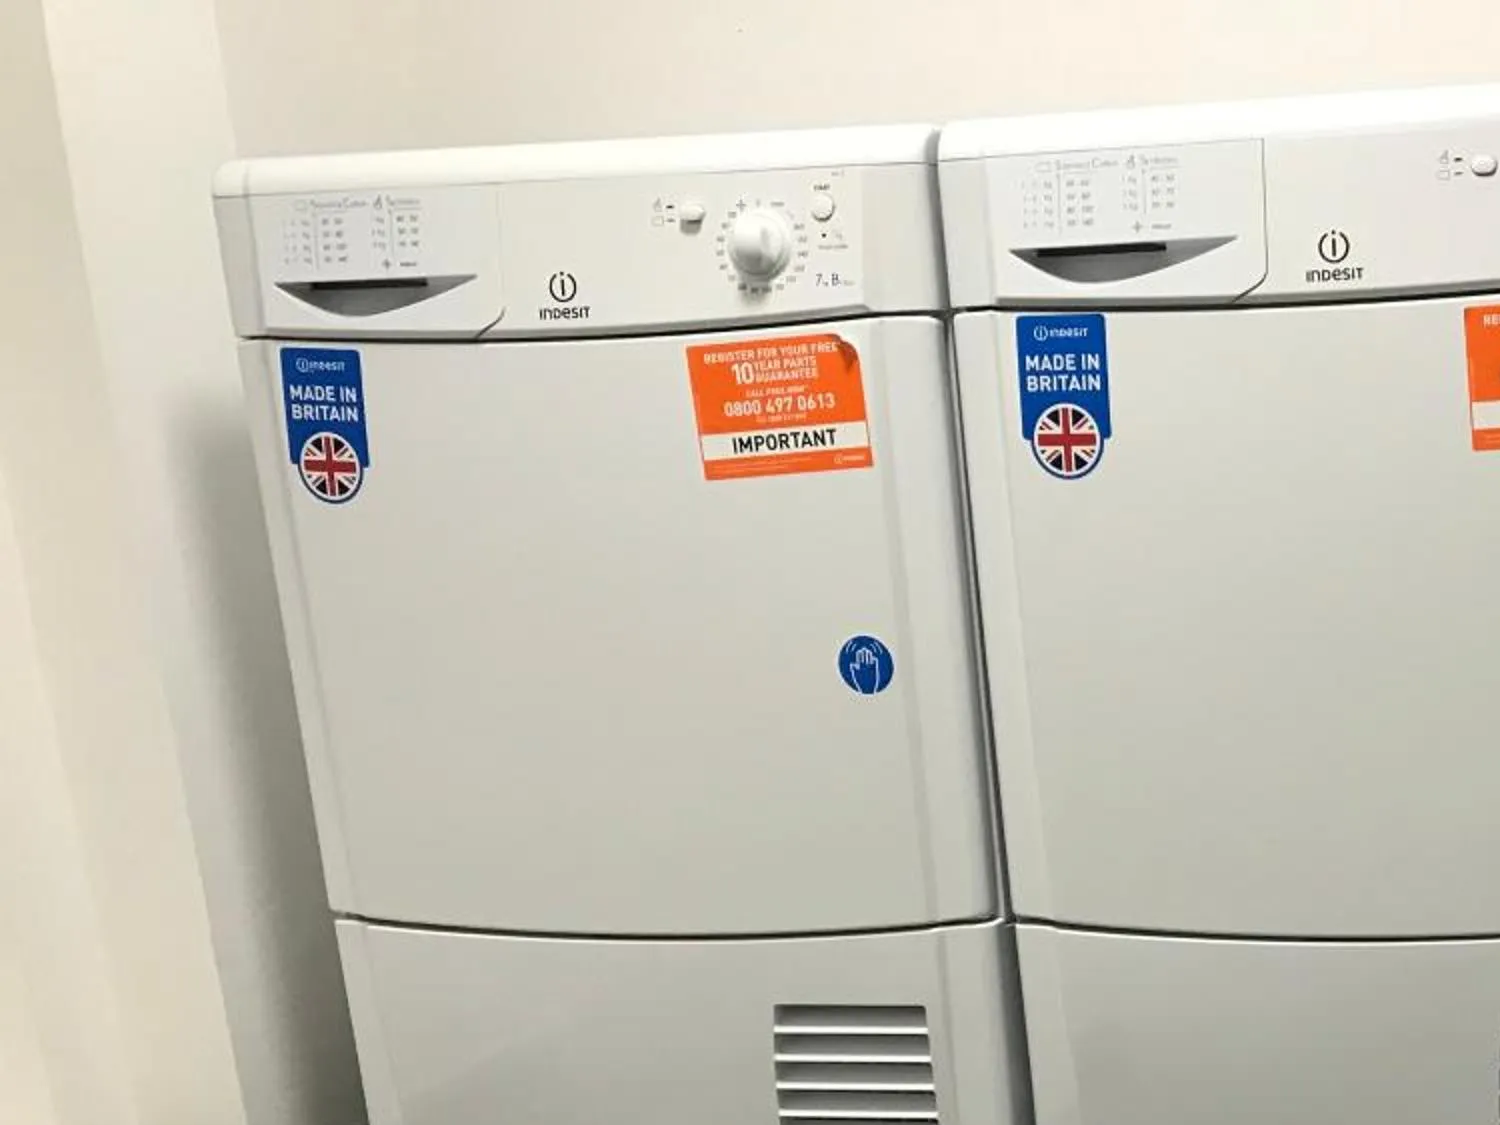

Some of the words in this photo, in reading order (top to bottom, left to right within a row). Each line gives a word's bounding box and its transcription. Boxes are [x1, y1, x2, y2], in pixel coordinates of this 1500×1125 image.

[1025, 353, 1076, 371] MADE
[1081, 353, 1100, 371] IN
[731, 361, 754, 385] 10
[1026, 374, 1101, 392] BRITAIN
[289, 384, 336, 401] MADE
[340, 385, 357, 403] IN
[291, 403, 359, 422] BRITAIN
[723, 400, 761, 417] 0800
[765, 395, 793, 414] 497
[797, 391, 836, 410] 0613
[731, 427, 837, 455] IMPORTANT
